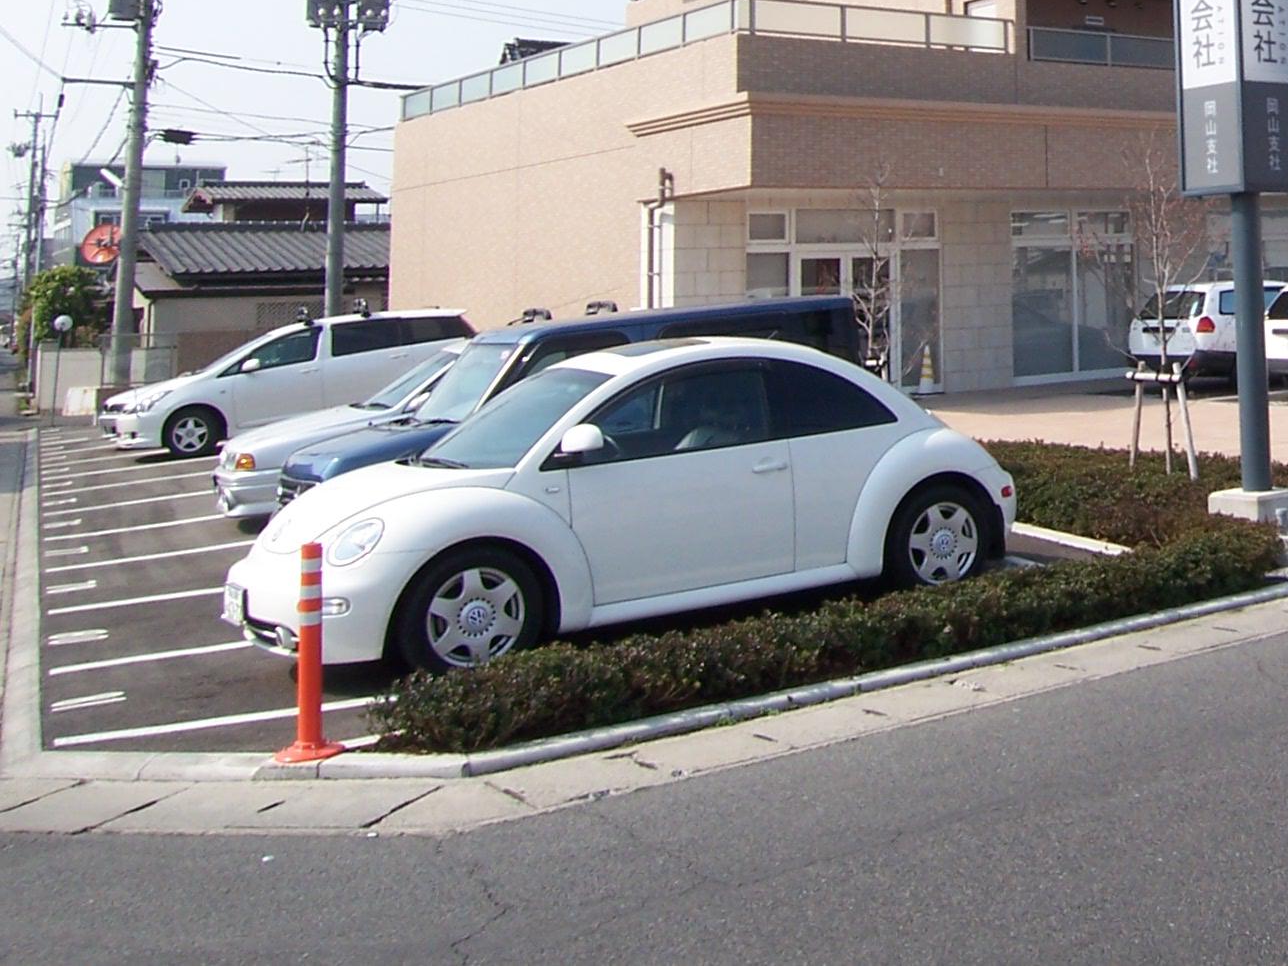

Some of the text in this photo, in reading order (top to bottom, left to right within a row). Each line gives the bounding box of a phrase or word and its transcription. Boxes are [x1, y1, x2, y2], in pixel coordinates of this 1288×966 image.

[1204, 99, 1218, 174] 岡山支社
[1266, 97, 1282, 171] 岡山支社
